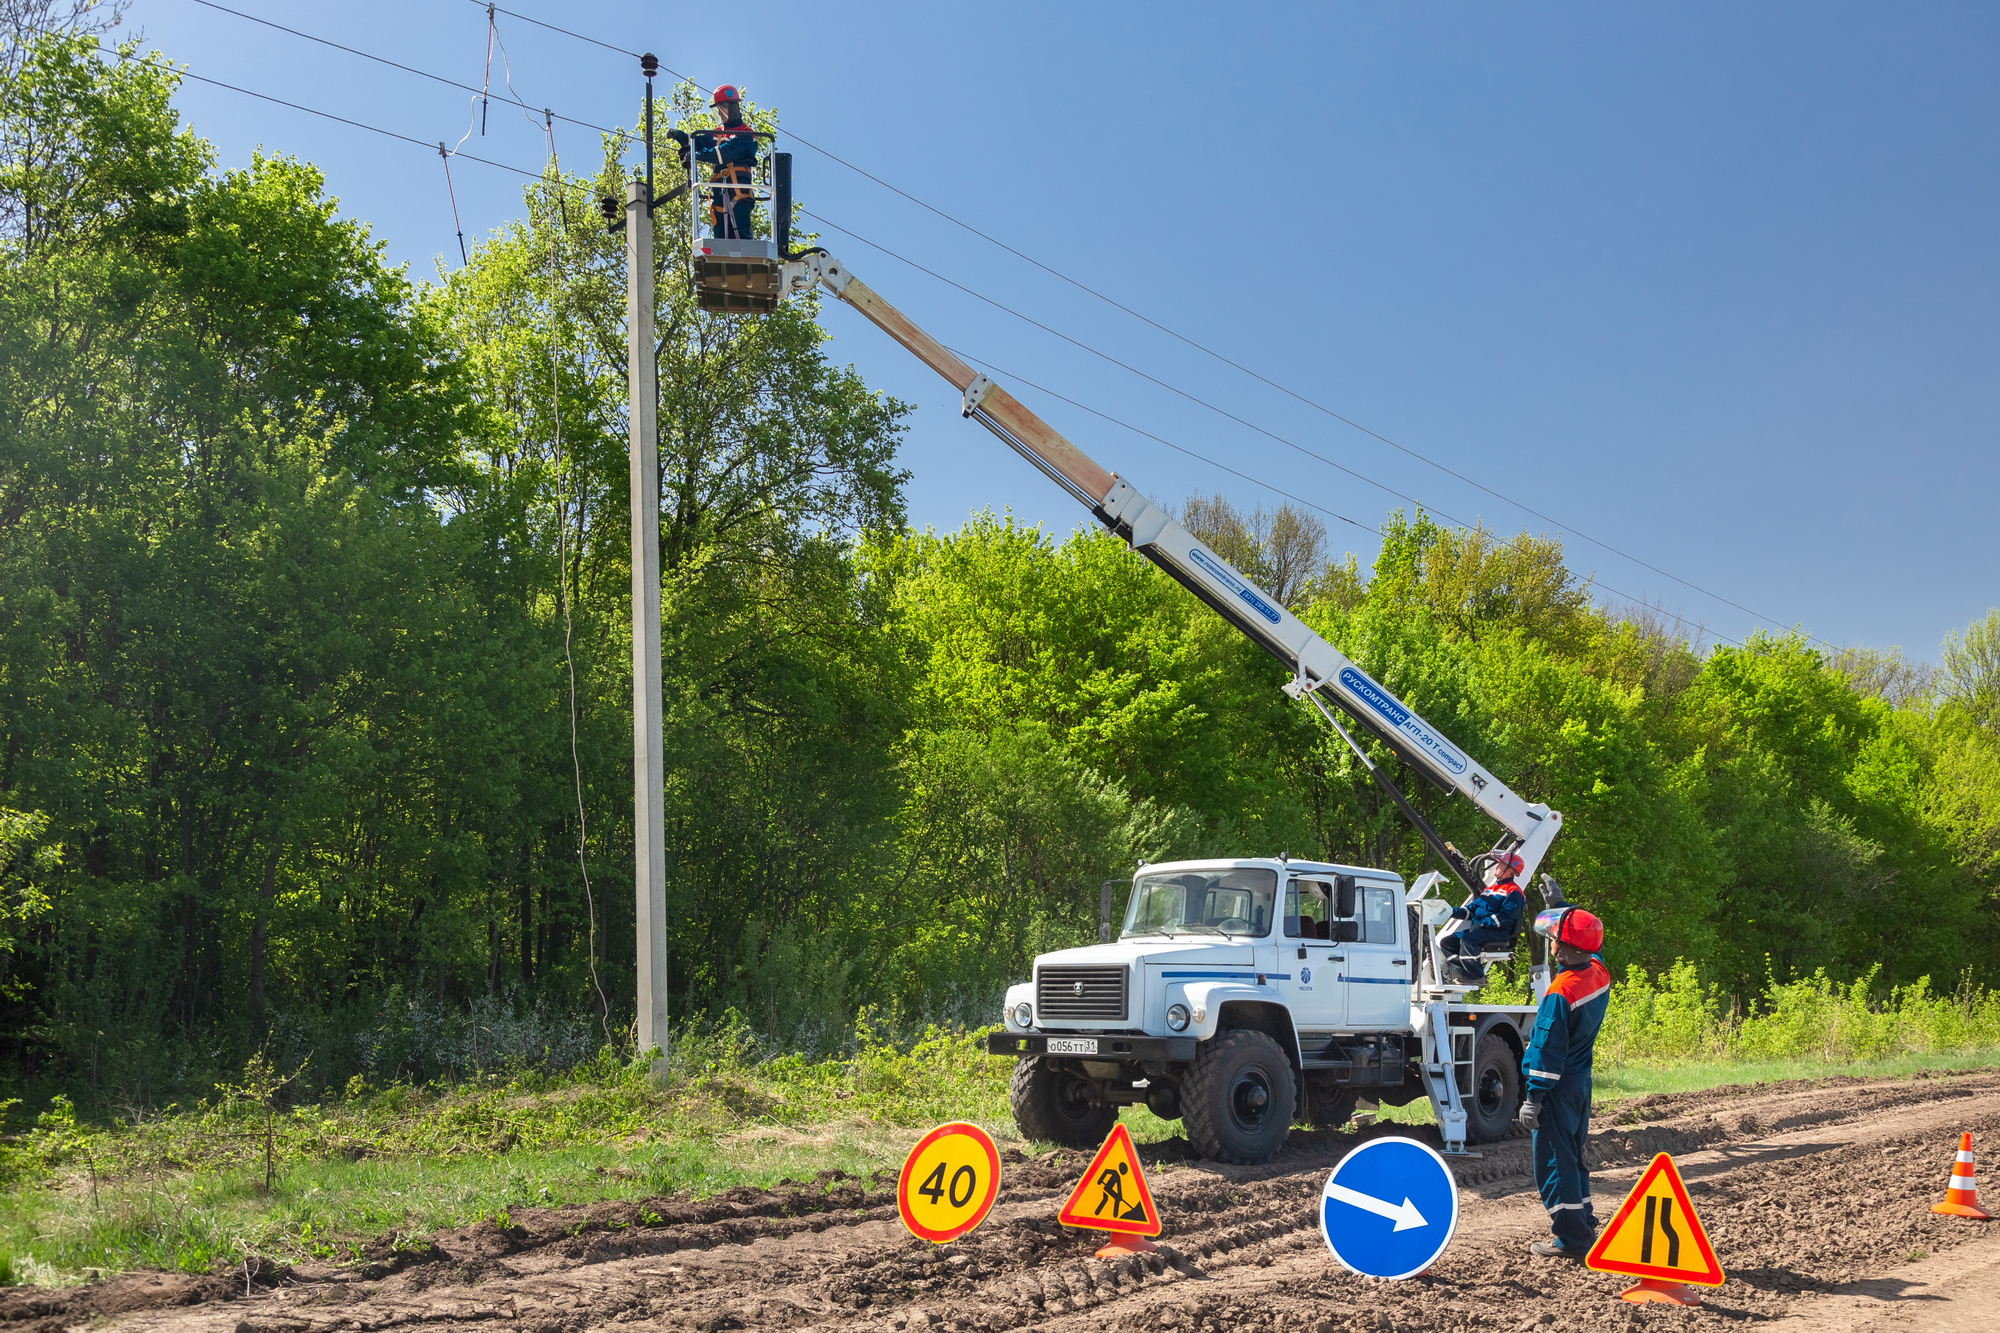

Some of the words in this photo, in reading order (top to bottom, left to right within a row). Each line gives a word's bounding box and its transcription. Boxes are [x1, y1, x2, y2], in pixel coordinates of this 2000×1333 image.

[1192, 552, 1242, 592] www.ruscomtrans.ru
[1342, 671, 1405, 723] РУСКОМТРАНС
[1403, 720, 1434, 746] АГП-20
[1437, 748, 1464, 771] compact
[918, 1162, 976, 1208] 40
